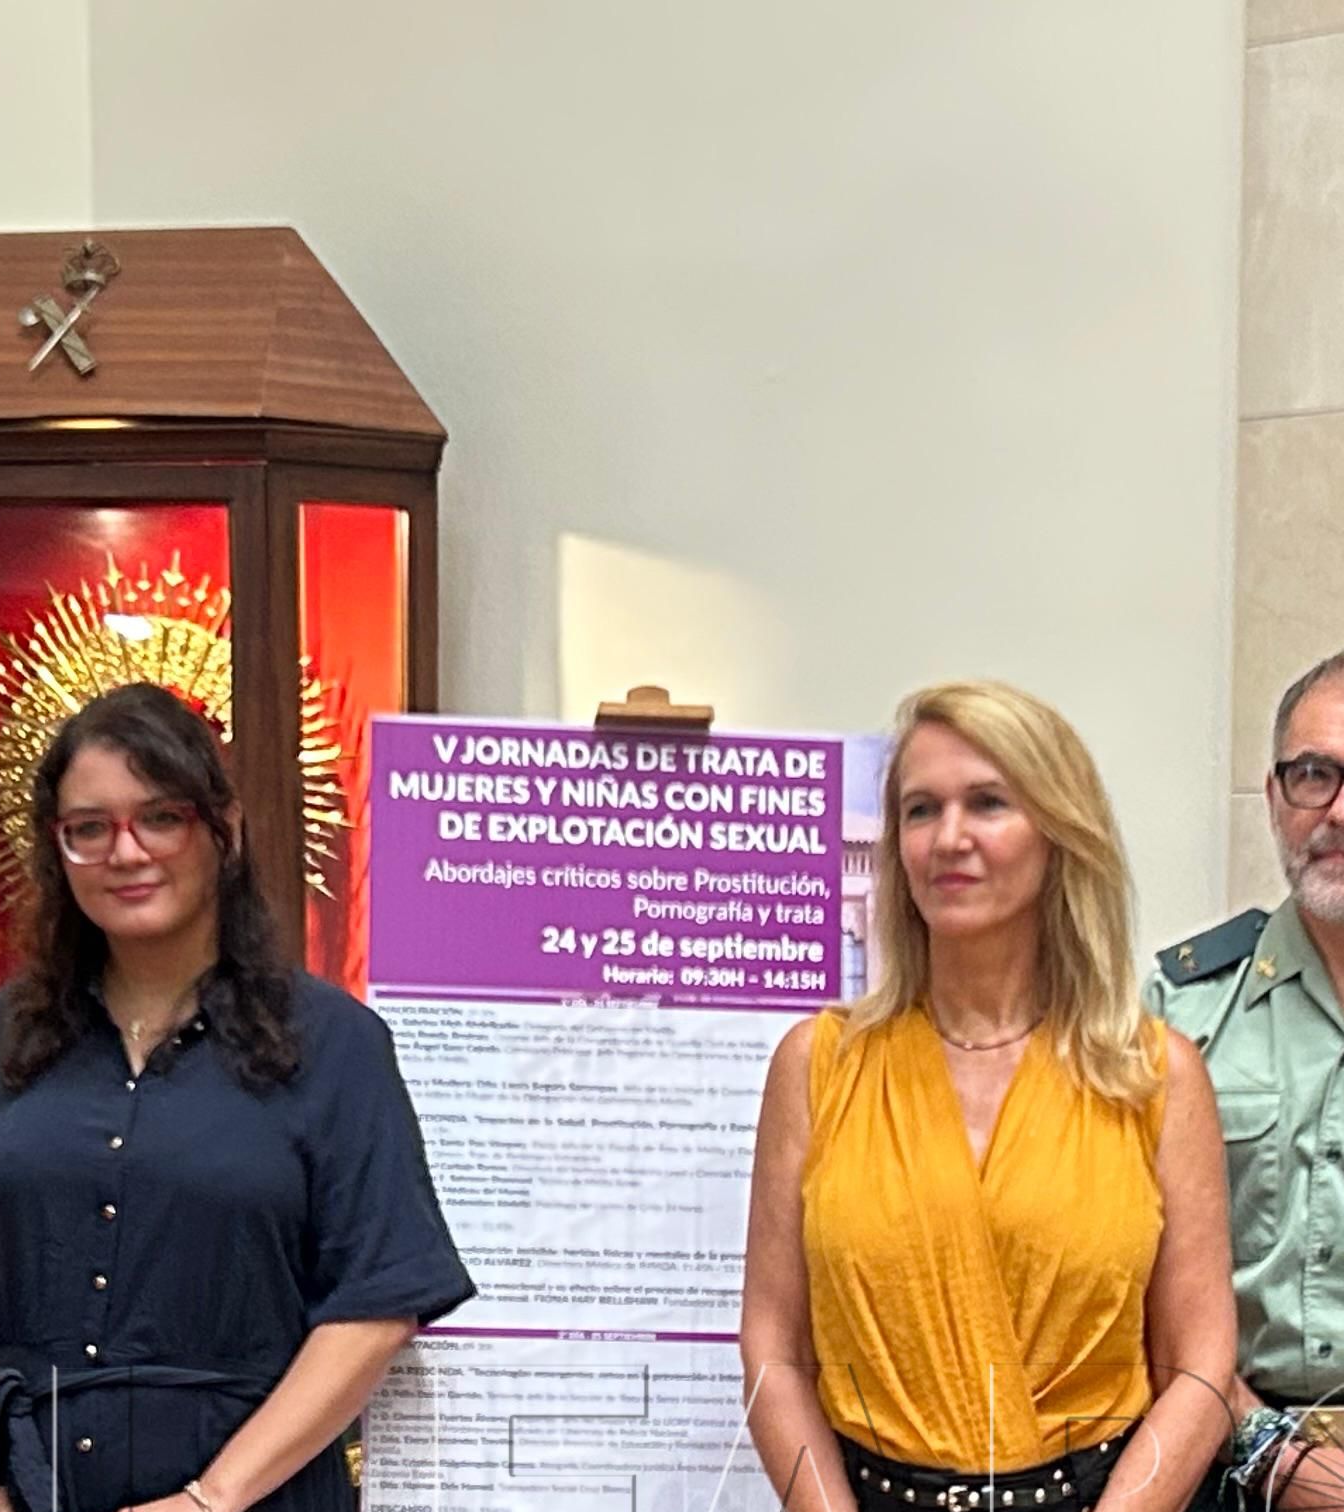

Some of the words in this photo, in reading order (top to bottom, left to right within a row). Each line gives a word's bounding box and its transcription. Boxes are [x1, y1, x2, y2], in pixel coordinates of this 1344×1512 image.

[433, 734, 458, 764] V
[460, 736, 628, 770] JORNADAS
[636, 743, 677, 772] DE
[683, 744, 779, 777] TRATA
[784, 749, 826, 779] DE
[390, 770, 531, 804] MUJERES
[534, 775, 557, 806] Y
[561, 774, 659, 811] NIÑAS
[664, 781, 733, 812] CON
[740, 785, 826, 817] FINES
[439, 810, 482, 840] DE
[488, 812, 703, 849] EXPLOTACIÓN
[709, 821, 827, 855] SEXUAL
[425, 857, 536, 889] Abordajes
[541, 863, 622, 889] críticos
[627, 864, 688, 891] sobre
[694, 867, 831, 900] Prostitución,
[633, 895, 753, 925] Pornografía
[757, 905, 771, 926] y
[775, 903, 824, 925] trata
[541, 925, 576, 954] 24
[579, 933, 598, 959] y
[602, 927, 636, 956] 25
[641, 929, 674, 957] de
[679, 931, 824, 963] septiembre
[602, 963, 675, 986] Horario:
[680, 965, 744, 988] 09:30H
[763, 967, 826, 991] 14:15H
